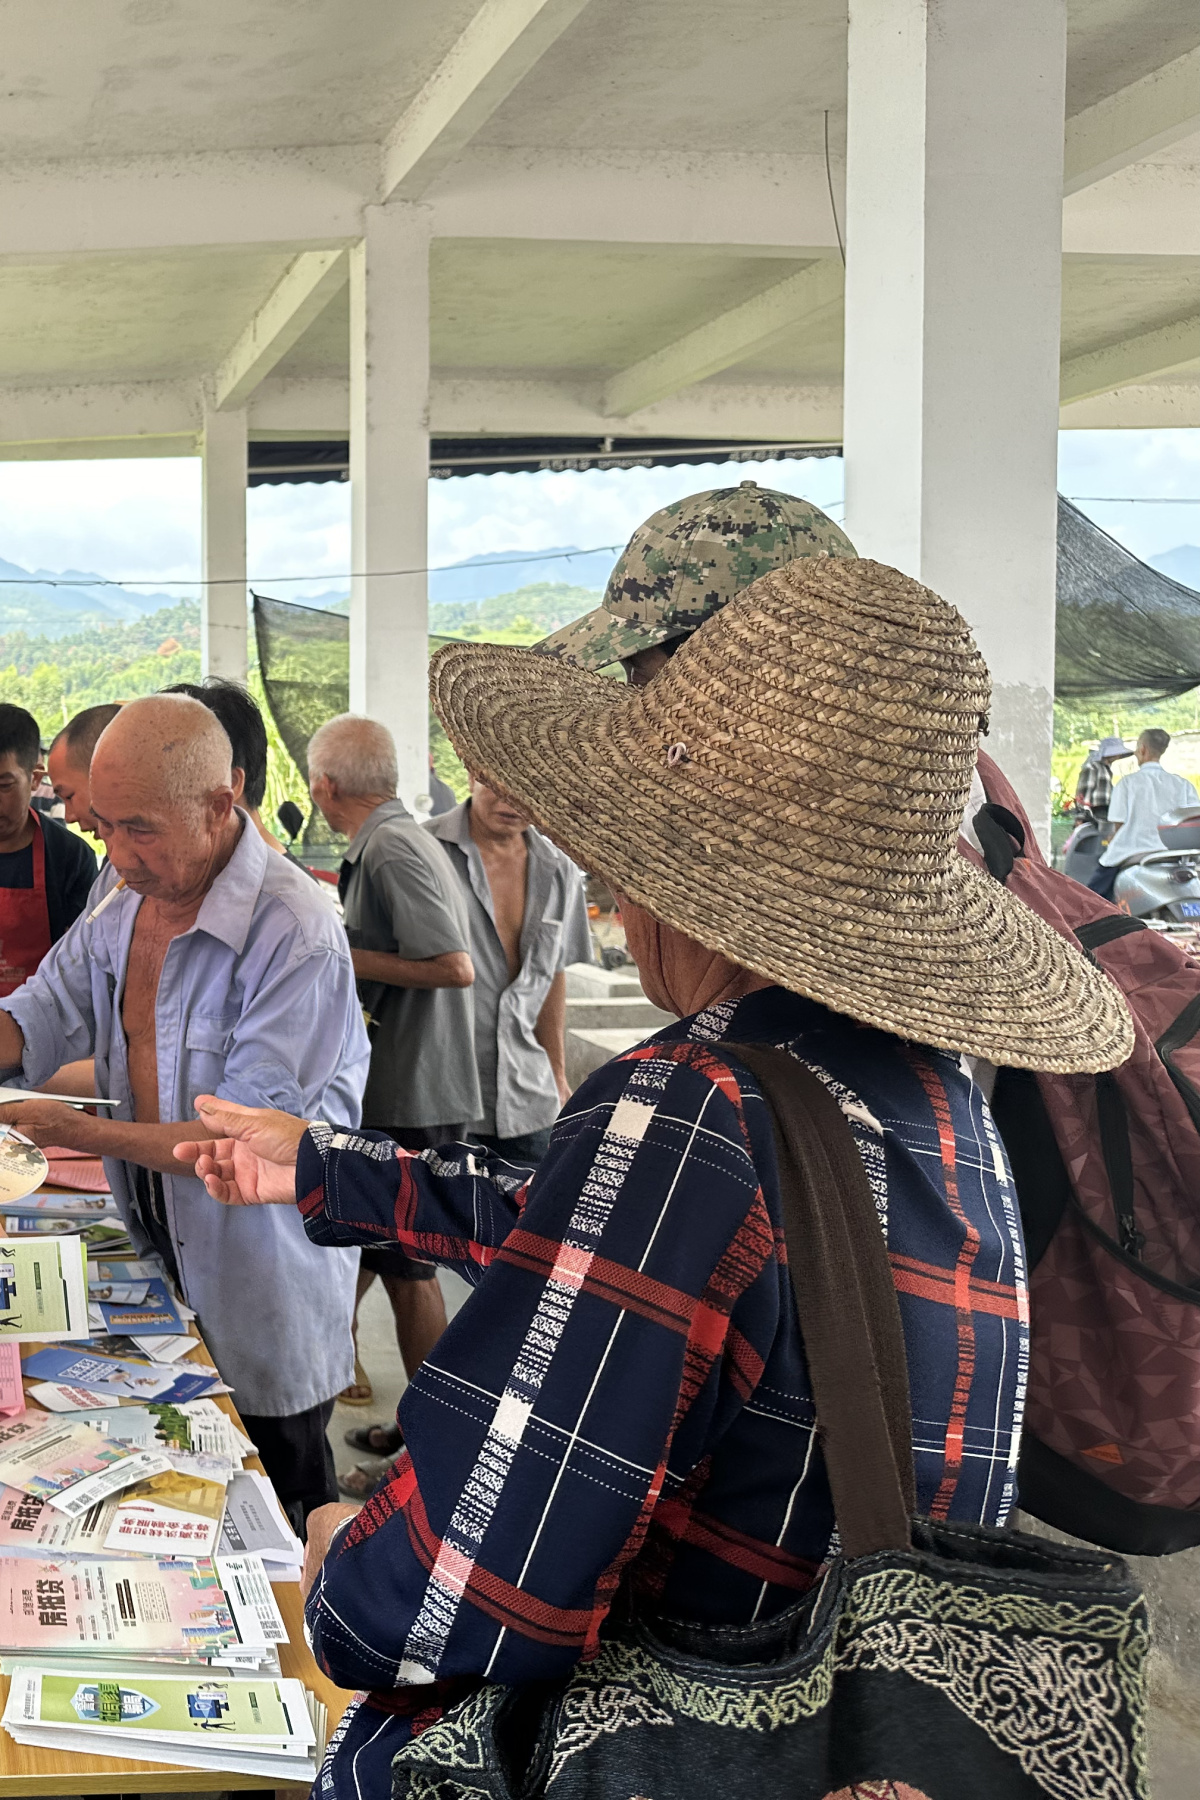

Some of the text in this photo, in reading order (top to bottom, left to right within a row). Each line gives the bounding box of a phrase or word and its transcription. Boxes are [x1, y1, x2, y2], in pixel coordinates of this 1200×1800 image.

[118, 1525, 209, 1541] 远离洗钱犯罪
[36, 1579, 68, 1627] 房抵贷
